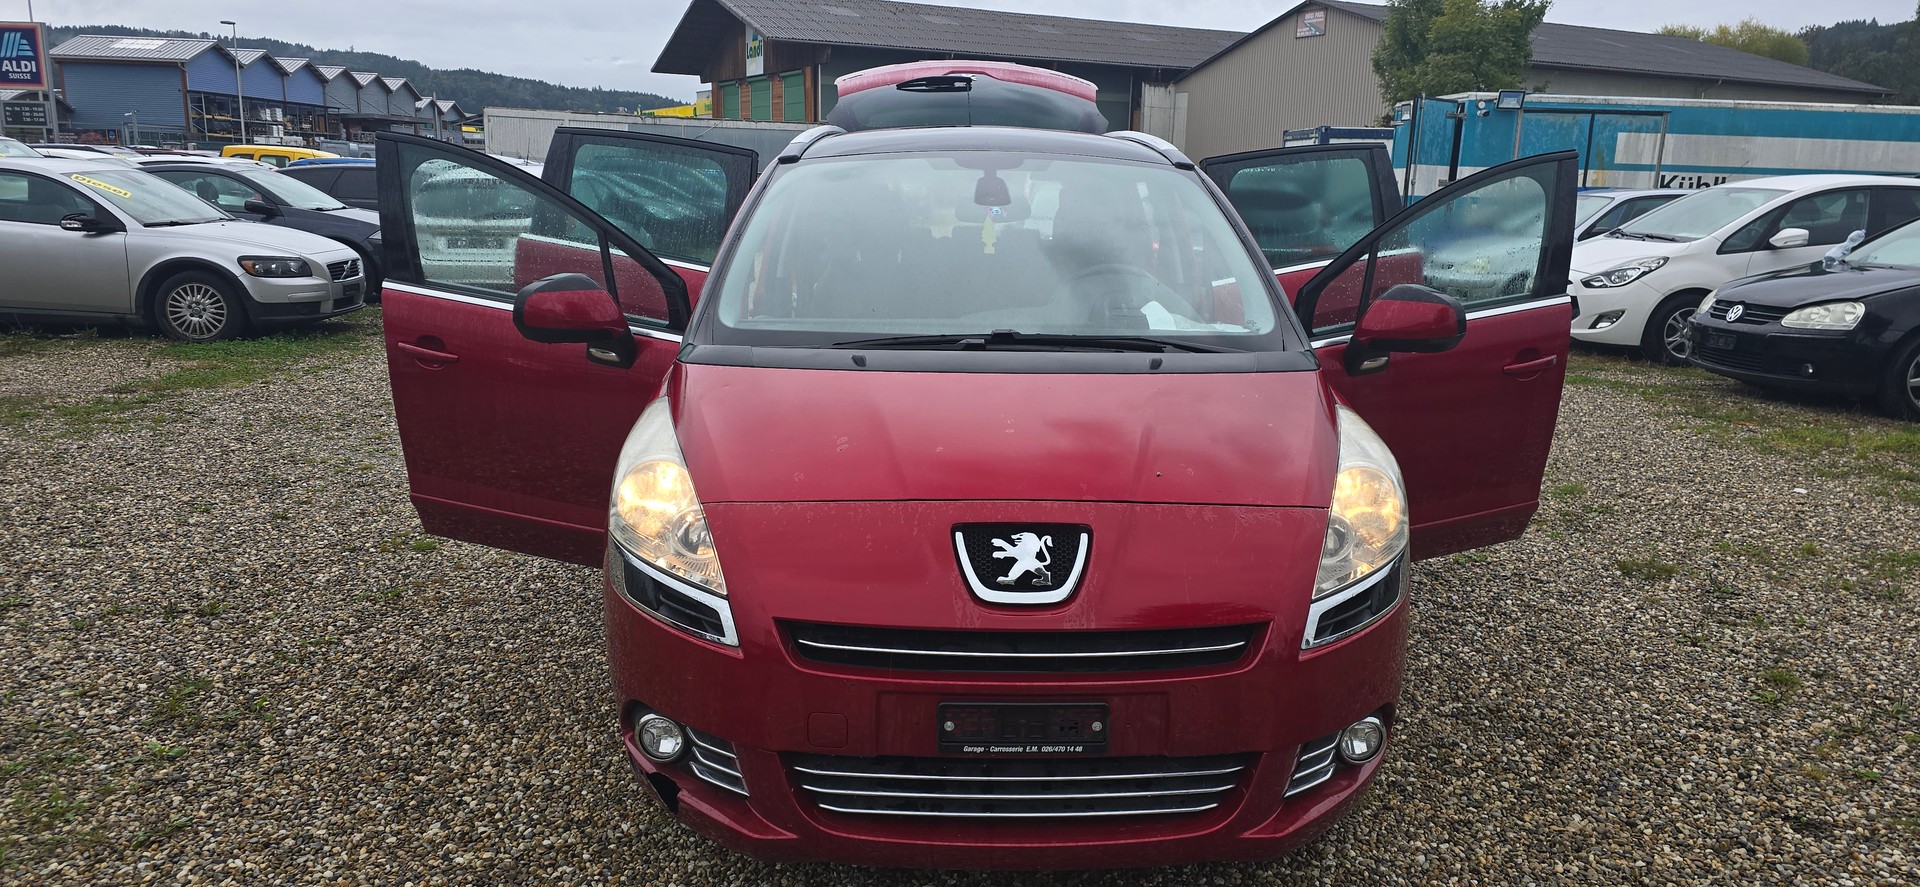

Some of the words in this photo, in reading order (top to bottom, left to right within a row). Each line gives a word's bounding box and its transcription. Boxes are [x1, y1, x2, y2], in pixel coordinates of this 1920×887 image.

[747, 40, 762, 59] Landi
[2, 60, 36, 72] ALDI
[74, 175, 128, 196] Diesel
